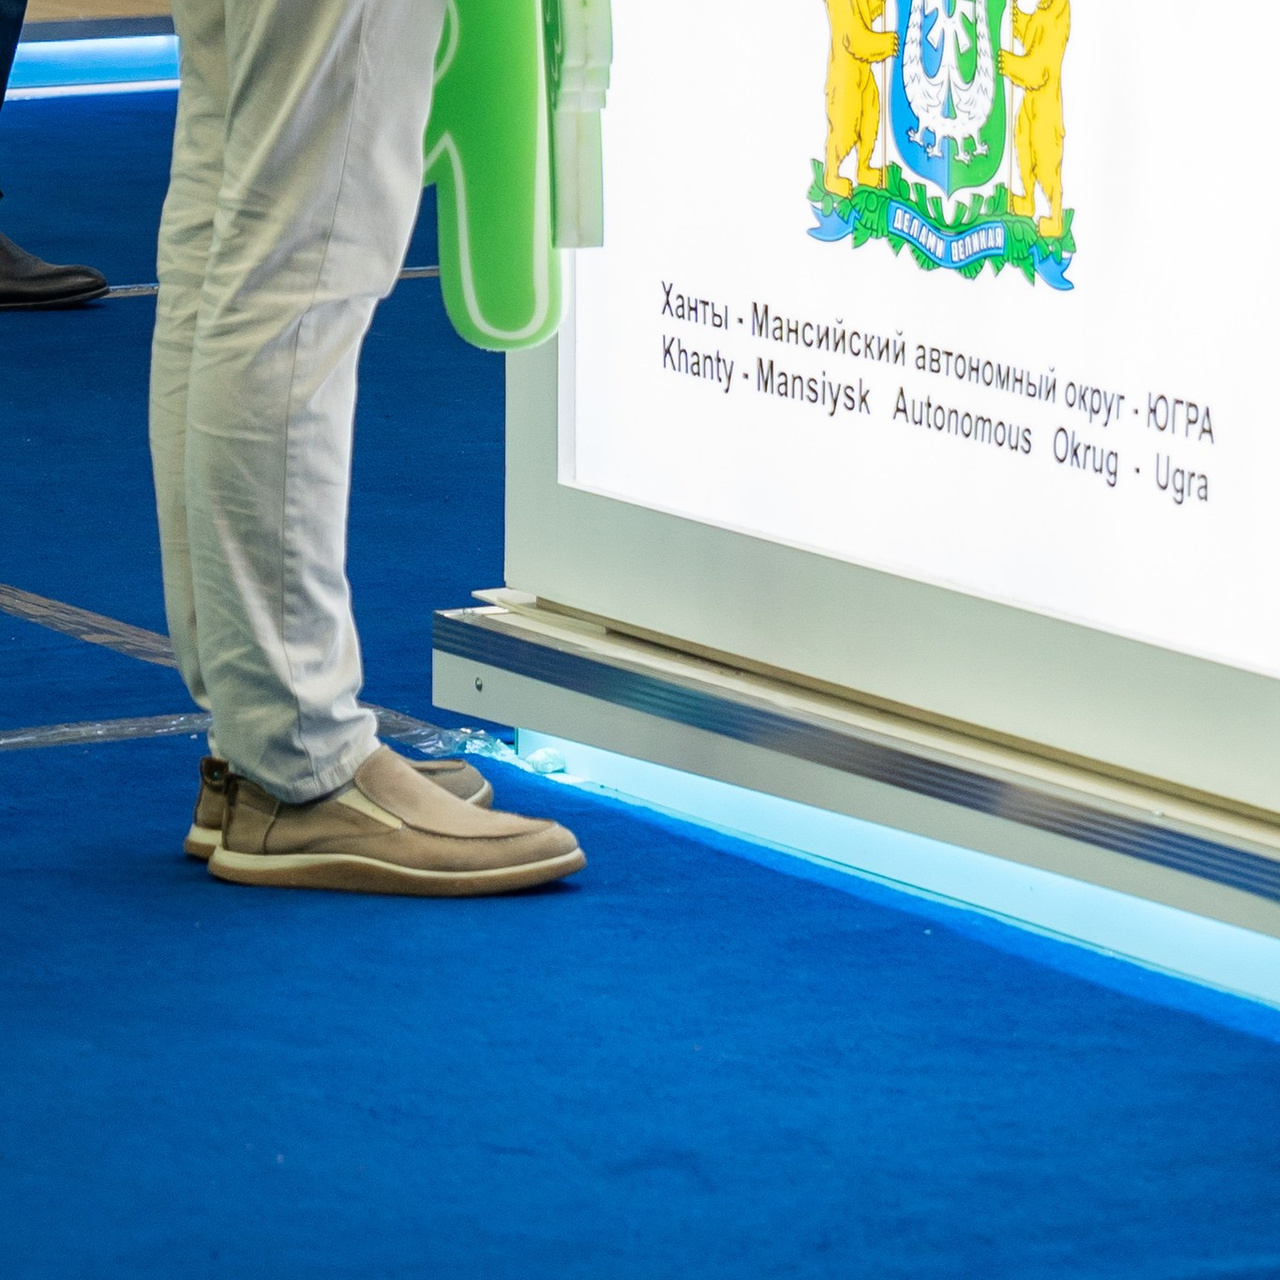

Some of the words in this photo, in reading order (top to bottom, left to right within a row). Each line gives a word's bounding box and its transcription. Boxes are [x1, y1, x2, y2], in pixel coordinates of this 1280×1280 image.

[893, 207, 945, 259] ДЕЛАМИ
[950, 225, 1004, 263] ВЕЛИКАЯ
[661, 280, 729, 330] Ханты
[751, 301, 907, 367] Мансийский
[915, 343, 1057, 404] автономный
[1064, 380, 1125, 427] округ
[1147, 391, 1215, 445] ЮГРА
[662, 334, 735, 393] Khanty
[757, 356, 871, 417] Mansiysk
[893, 386, 1032, 454] Autonomous
[1053, 426, 1119, 487] Okrug
[1155, 452, 1209, 505] Ugra
